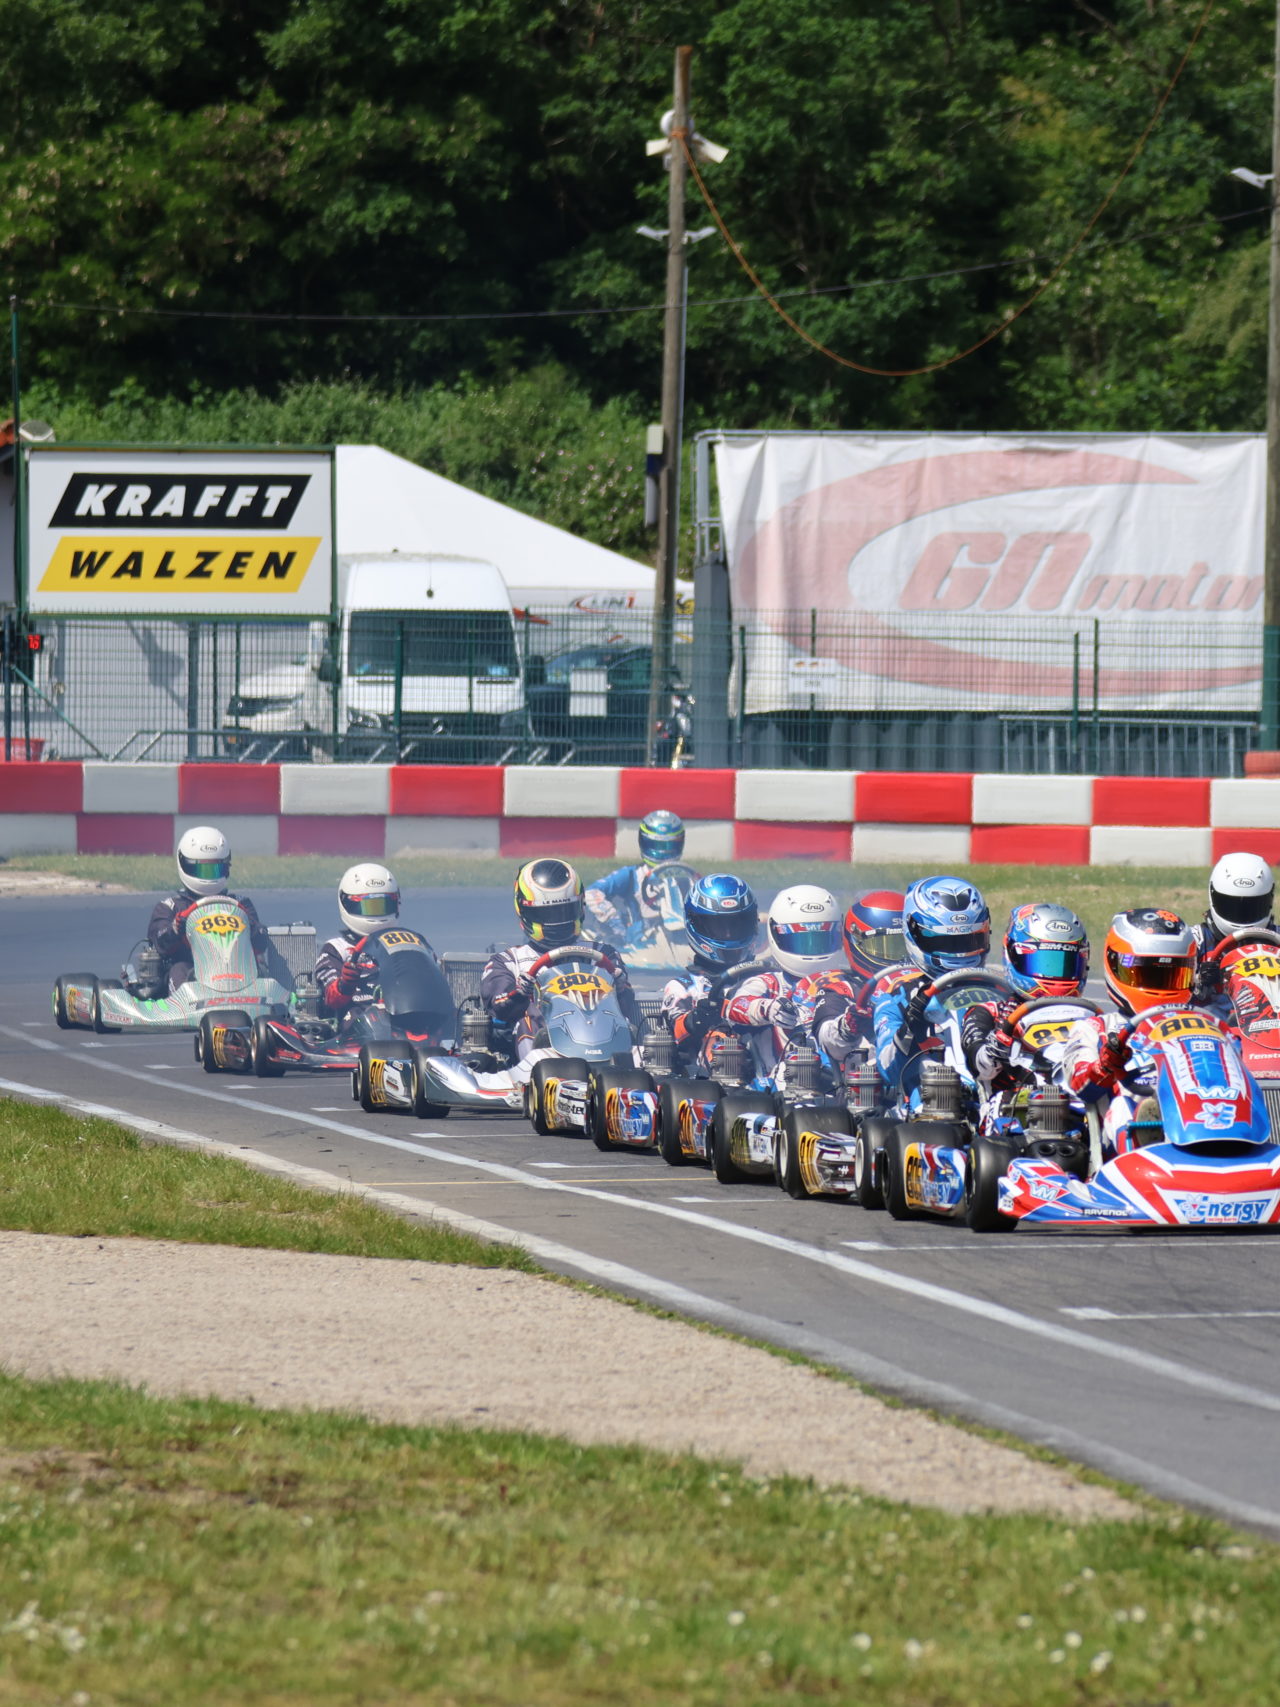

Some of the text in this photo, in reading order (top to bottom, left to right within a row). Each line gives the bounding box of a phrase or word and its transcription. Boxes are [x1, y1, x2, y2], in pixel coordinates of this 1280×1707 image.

[75, 484, 292, 517] KRAFFT
[70, 550, 297, 579] WALZEN
[805, 903, 823, 913] Arai
[201, 915, 240, 932] 869
[946, 926, 974, 934] MAGIK
[1051, 922, 1070, 931] Arai
[557, 972, 601, 992] 804
[1033, 1026, 1071, 1046] 81
[1084, 1208, 1128, 1217] RAVENOL
[1194, 1195, 1267, 1222] Energy
